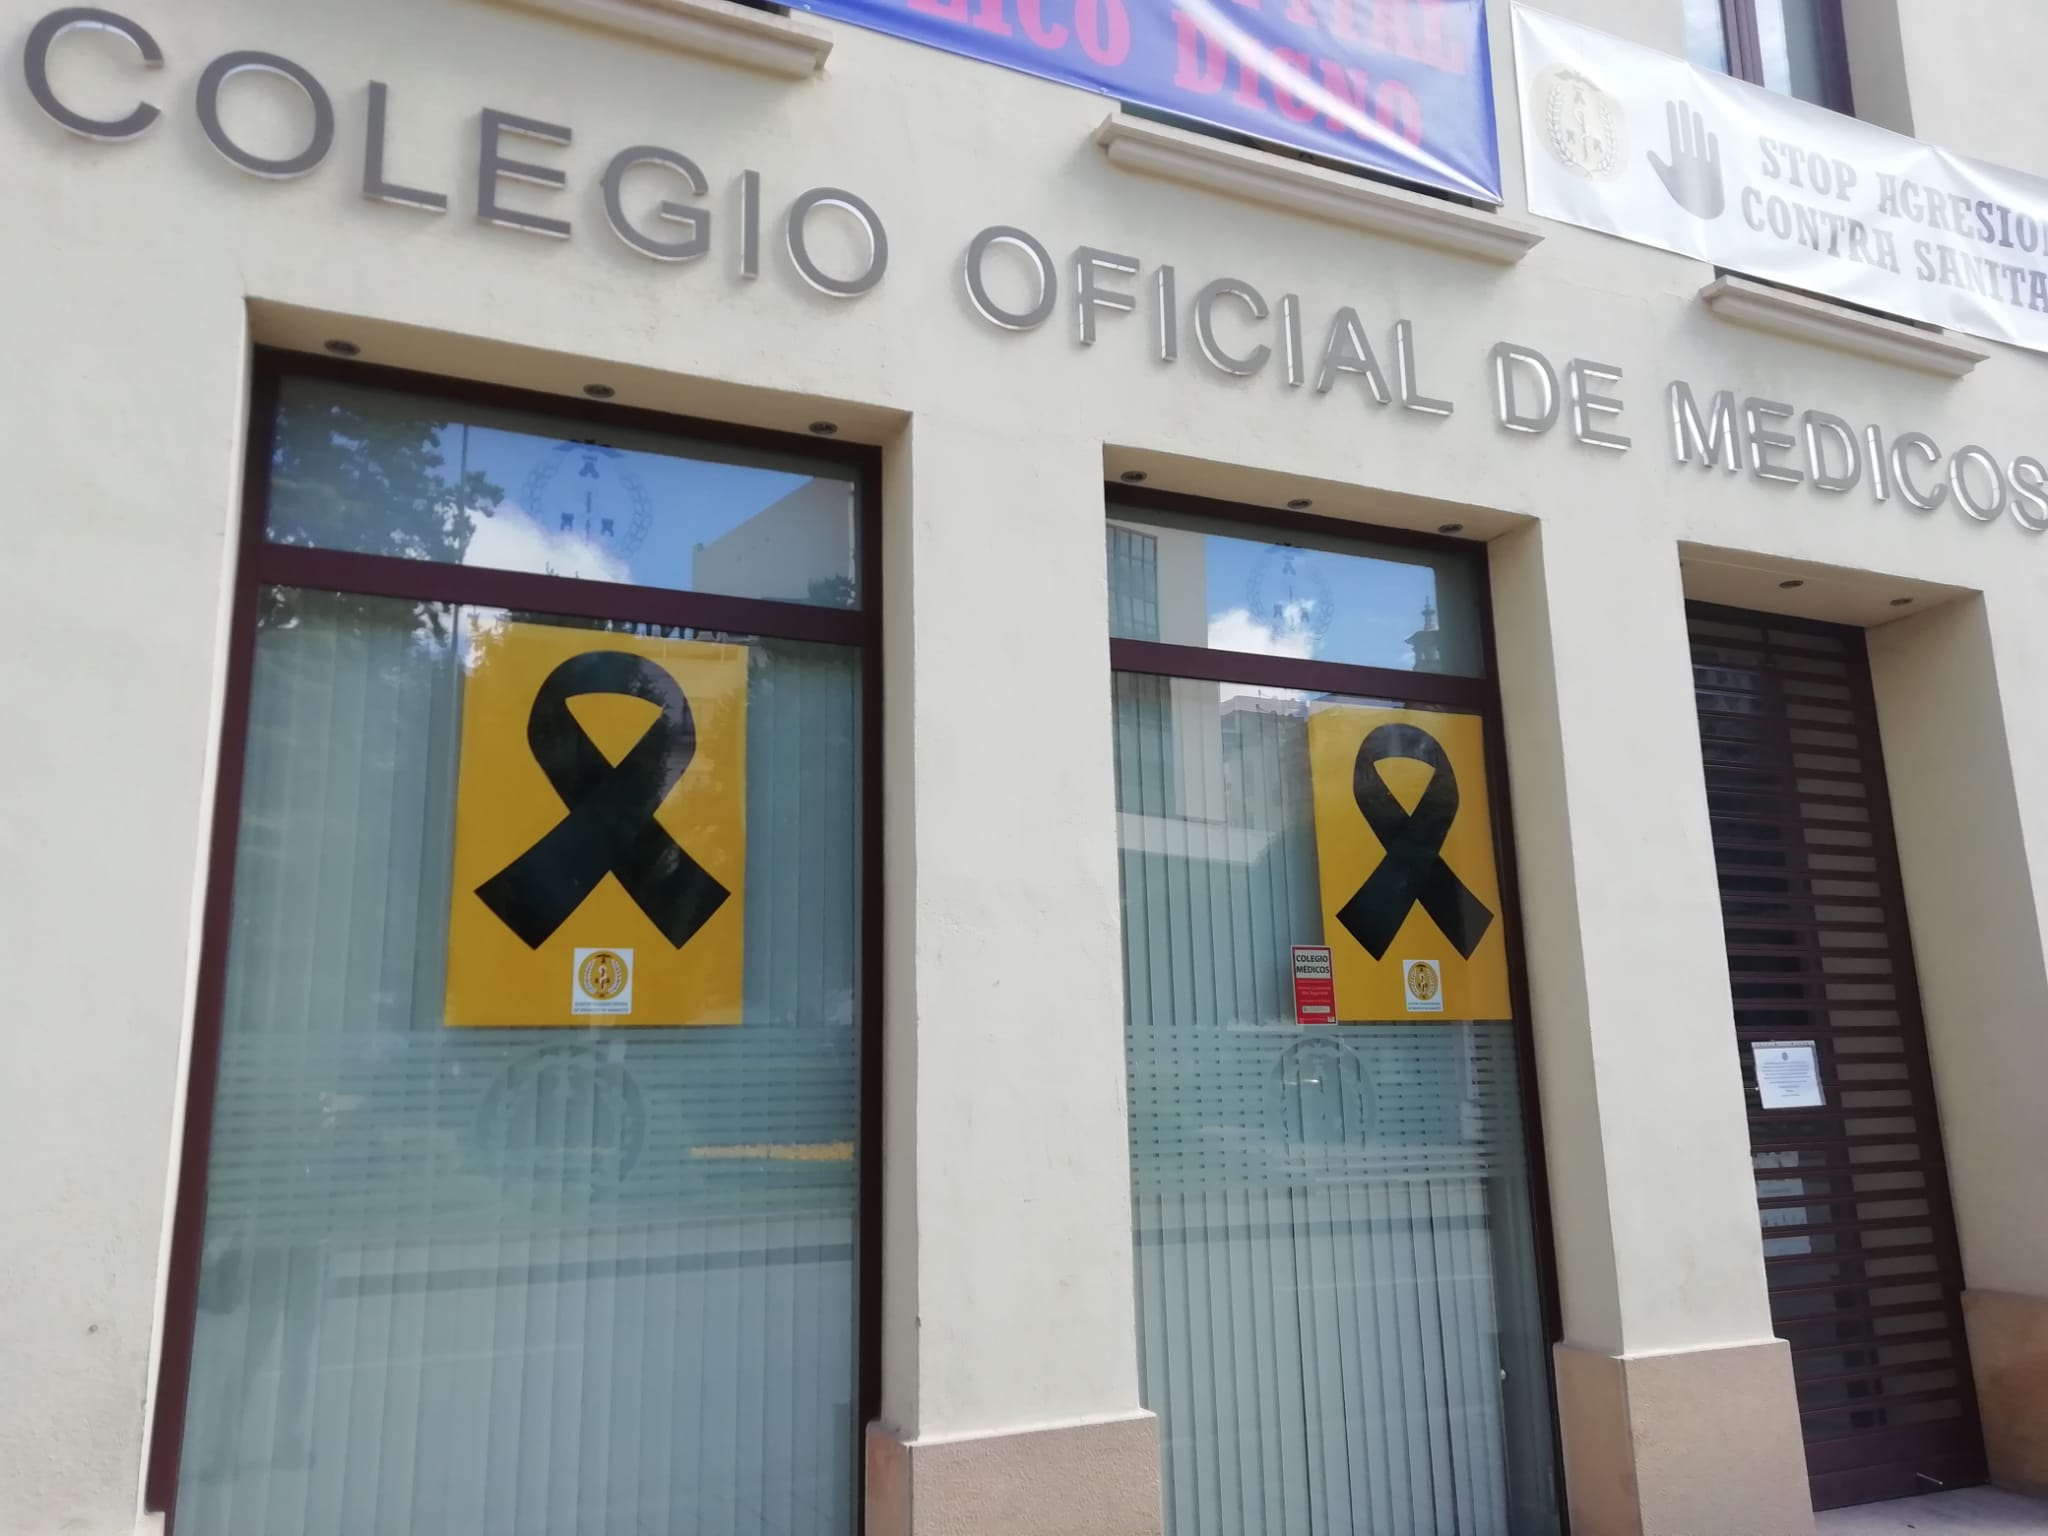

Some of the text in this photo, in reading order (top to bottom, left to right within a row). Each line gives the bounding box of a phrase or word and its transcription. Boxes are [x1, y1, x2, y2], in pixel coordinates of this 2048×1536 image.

[1758, 135, 1857, 202] STOP
[24, 6, 2048, 531] COLEGIO OFICIAL DE MEDICOS
[1741, 186, 2048, 314] CONTRA SANITA
[1296, 954, 1329, 963] COLEGIO
